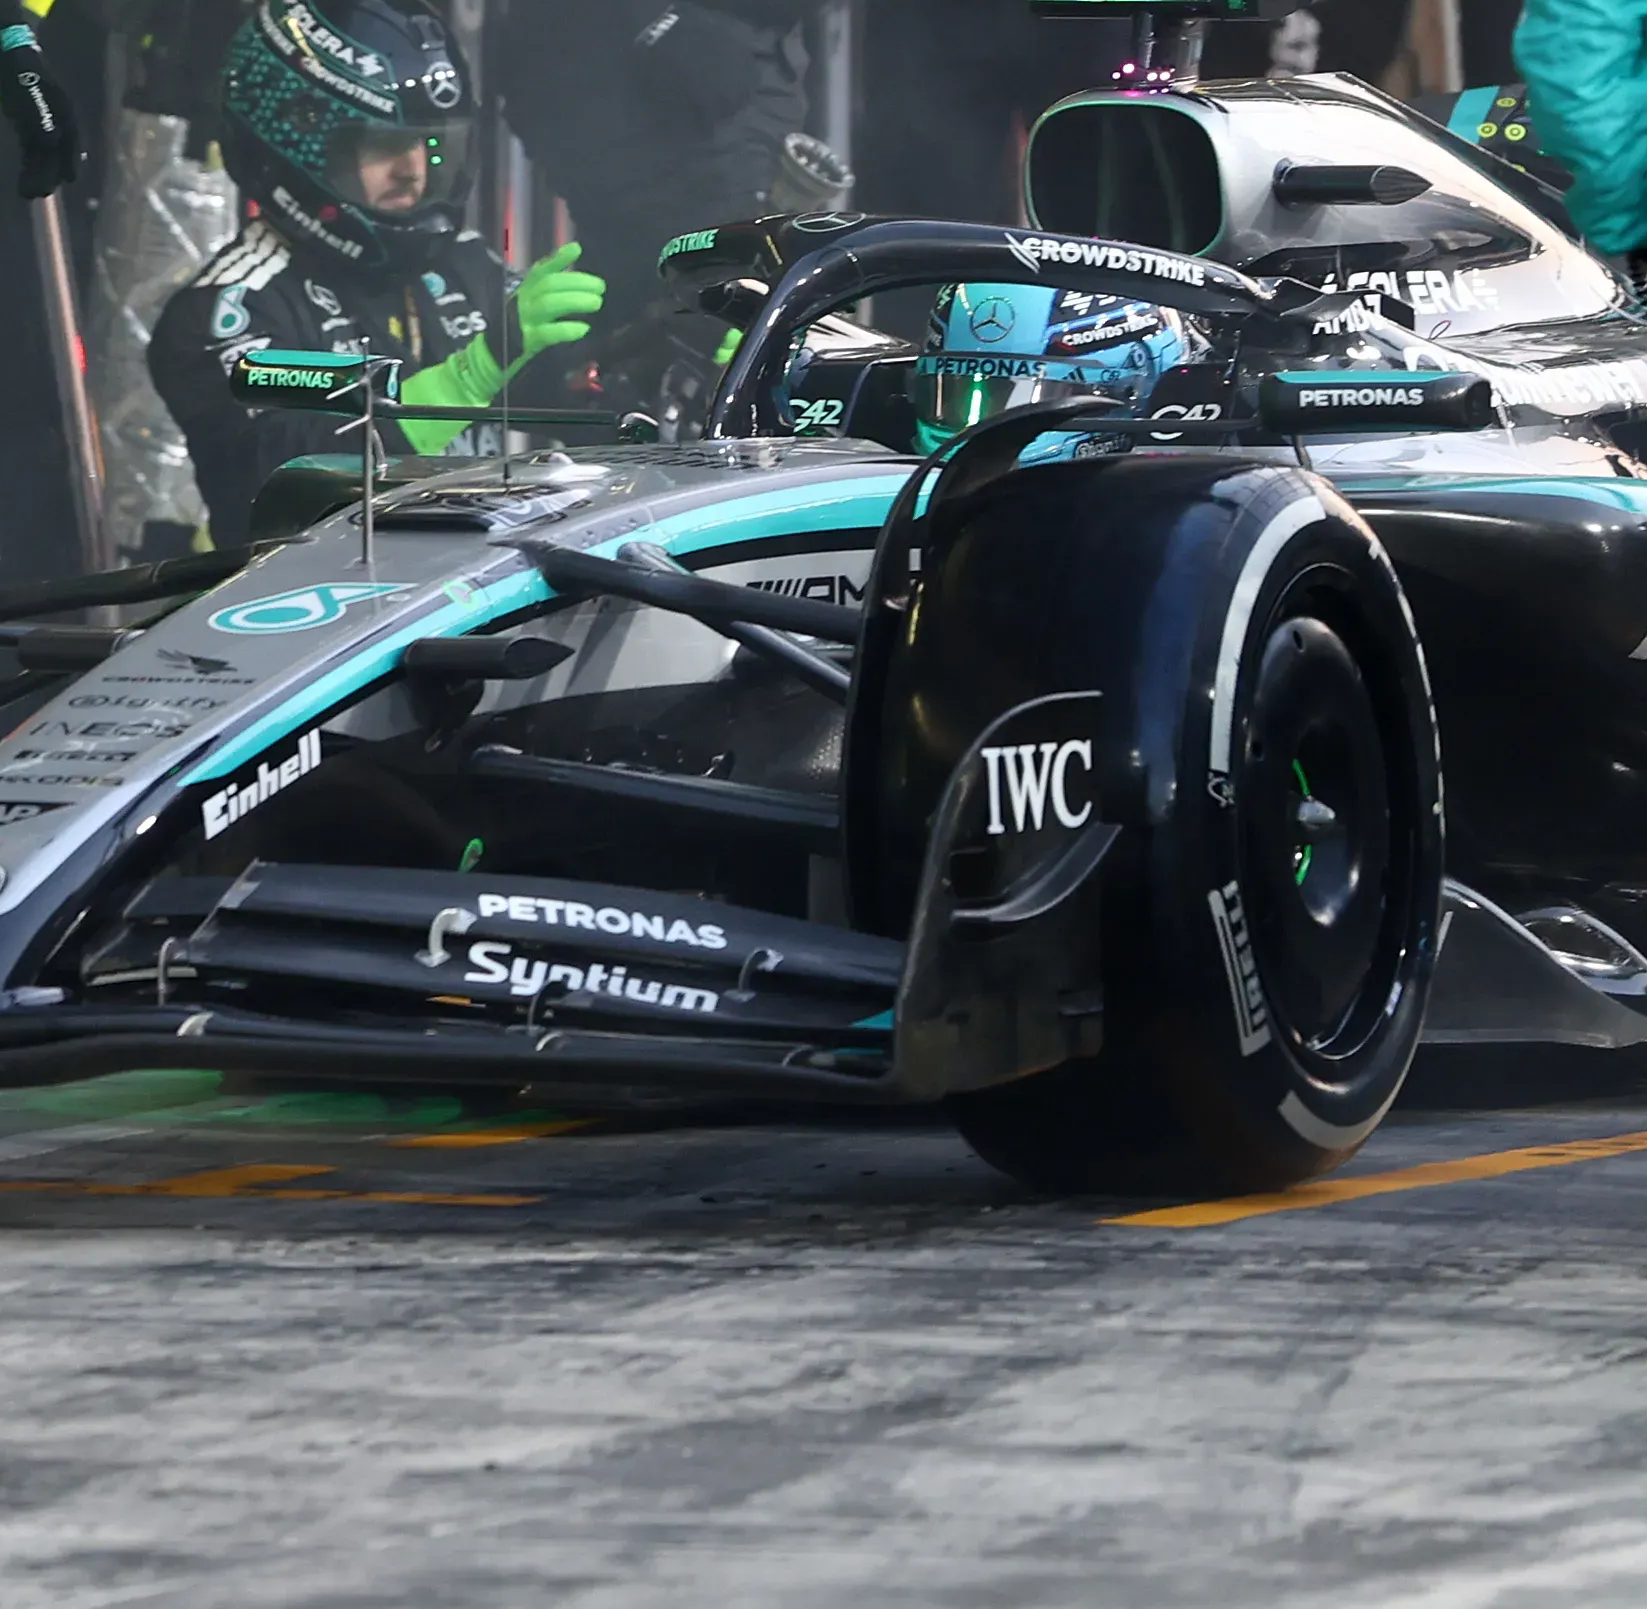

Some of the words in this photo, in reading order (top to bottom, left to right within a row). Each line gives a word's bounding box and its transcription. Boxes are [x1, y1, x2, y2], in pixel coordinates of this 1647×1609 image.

[1020, 236, 1206, 286] CROWDSTRIKE
[247, 369, 334, 389] PETRONAS
[934, 358, 1047, 379] PETRONAS
[1298, 388, 1425, 408] PETRONAS
[202, 728, 322, 841] Einhell
[981, 739, 1094, 835] IWC
[477, 893, 729, 950] PETRONAS
[464, 941, 720, 1013] Syntium
